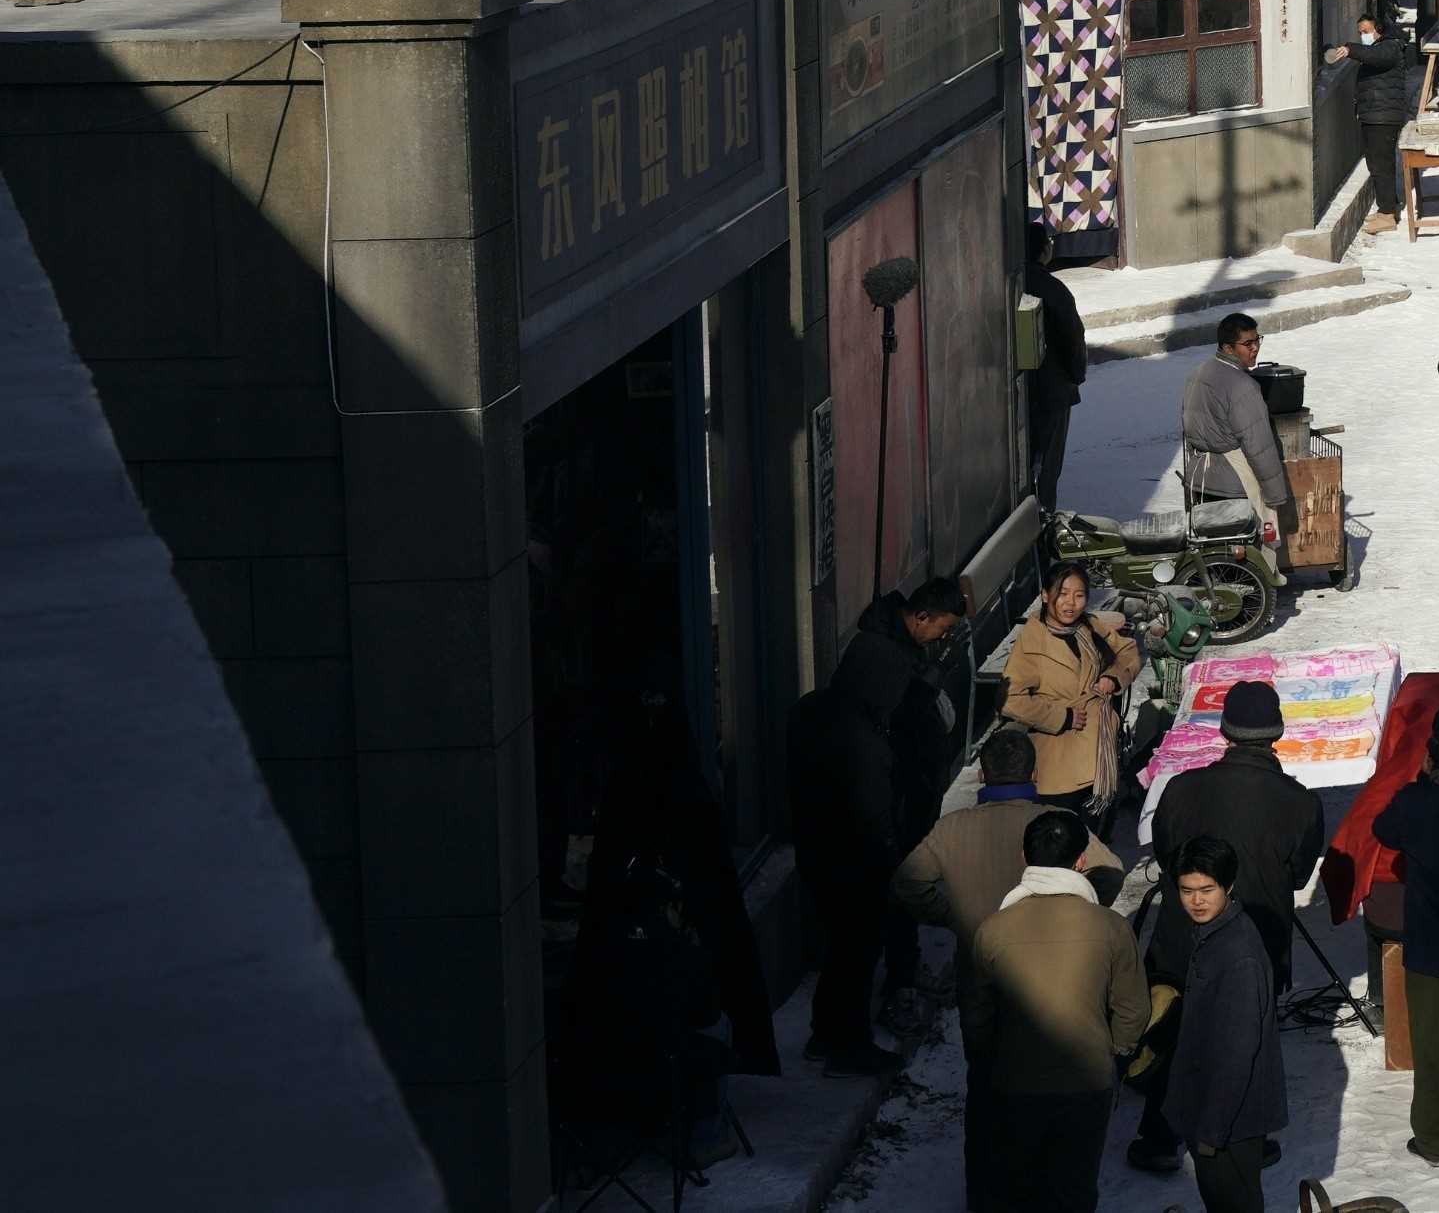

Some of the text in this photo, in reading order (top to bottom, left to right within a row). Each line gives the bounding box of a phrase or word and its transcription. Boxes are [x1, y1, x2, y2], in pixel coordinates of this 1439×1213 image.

[537, 28, 749, 261] 东风照相馆
